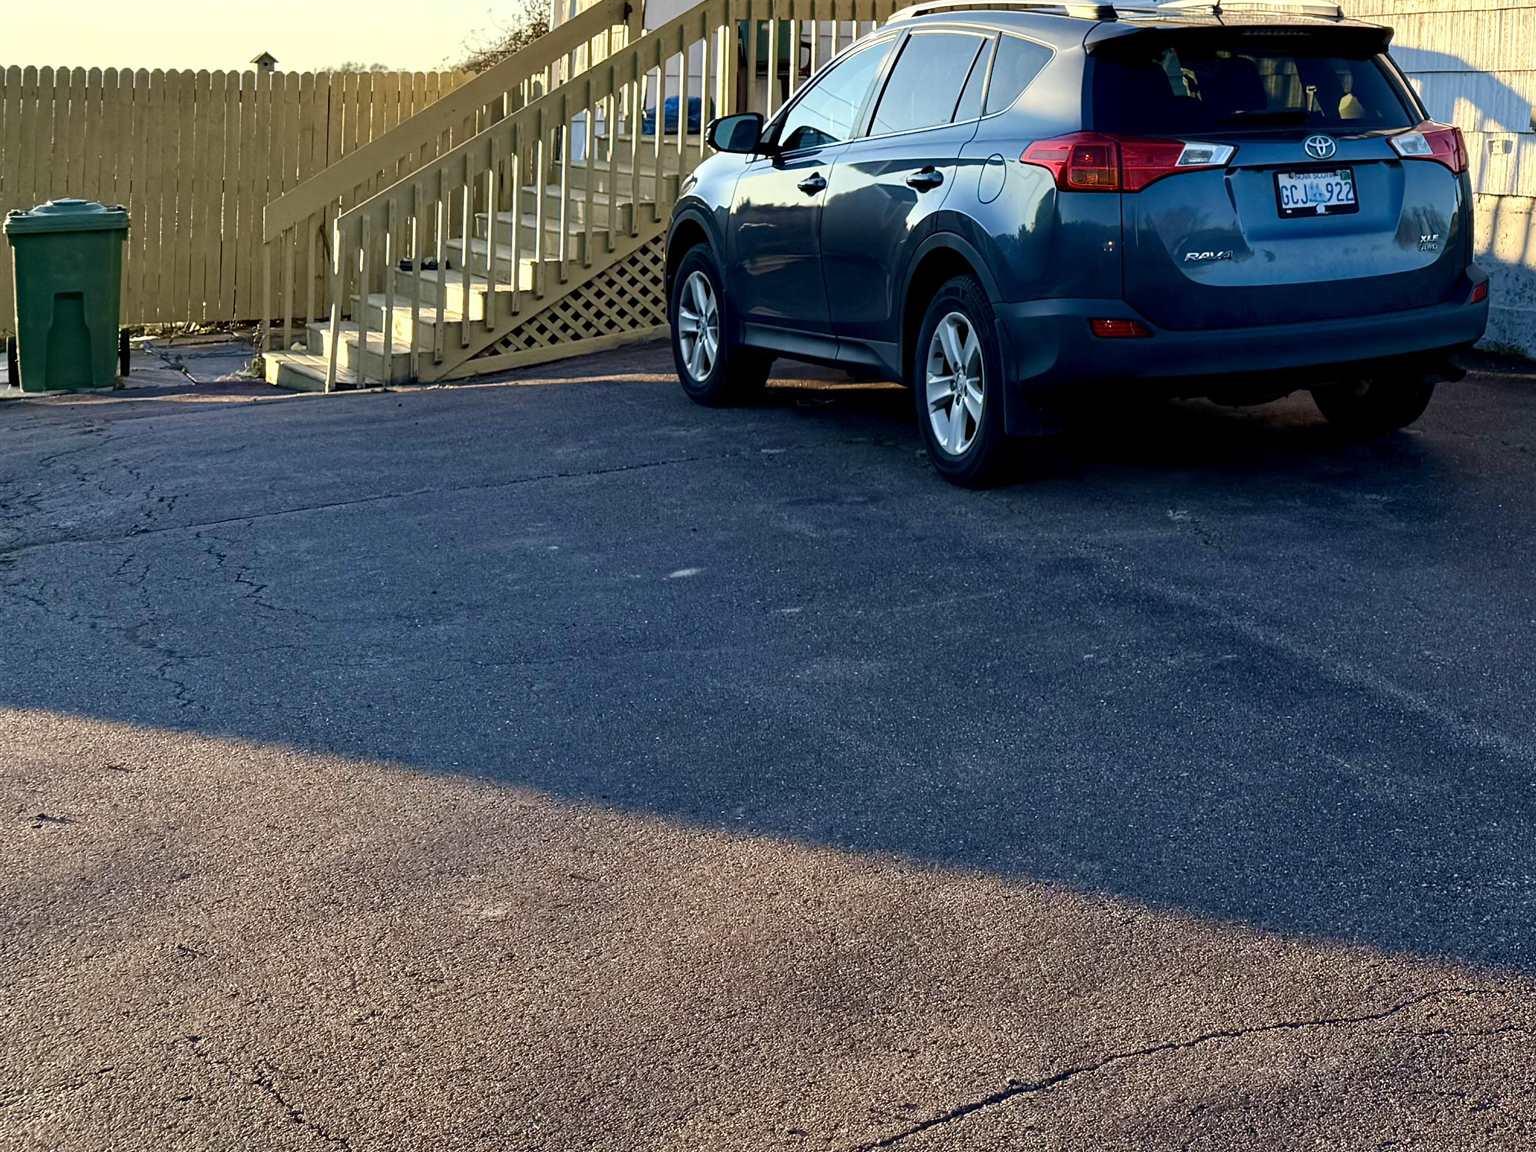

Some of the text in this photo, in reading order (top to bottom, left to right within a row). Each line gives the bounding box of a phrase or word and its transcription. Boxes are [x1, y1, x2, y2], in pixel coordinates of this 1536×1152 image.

[1281, 181, 1353, 205] GCJ 922
[1184, 250, 1233, 262] RAV4
